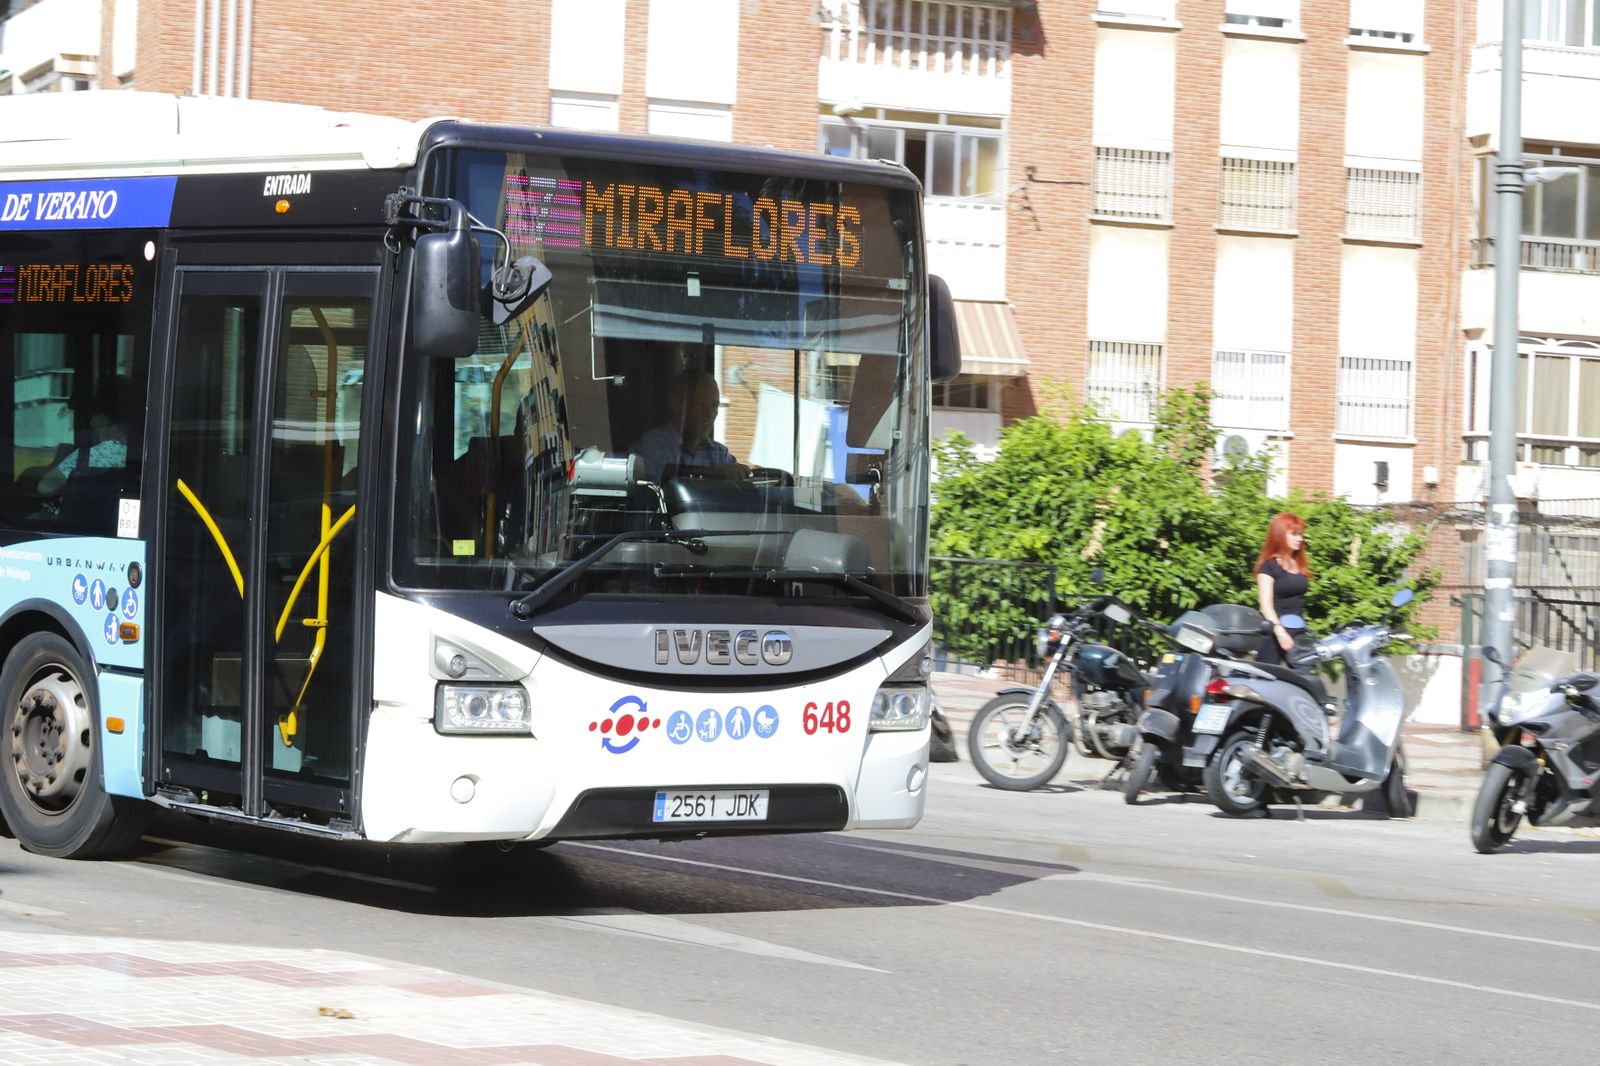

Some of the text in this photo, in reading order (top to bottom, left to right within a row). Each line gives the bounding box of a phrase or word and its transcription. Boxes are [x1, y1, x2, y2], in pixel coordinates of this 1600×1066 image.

[263, 173, 312, 197] ENTRADA
[0, 189, 118, 222] DE VERANO
[584, 180, 862, 268] MIRAFLORES
[17, 263, 134, 303] MIRAFLORES
[0, 550, 42, 561] yuntamiento
[654, 629, 794, 666] IVECO
[802, 700, 851, 735] 648
[670, 794, 717, 818] 2561
[725, 793, 760, 817] JDK
